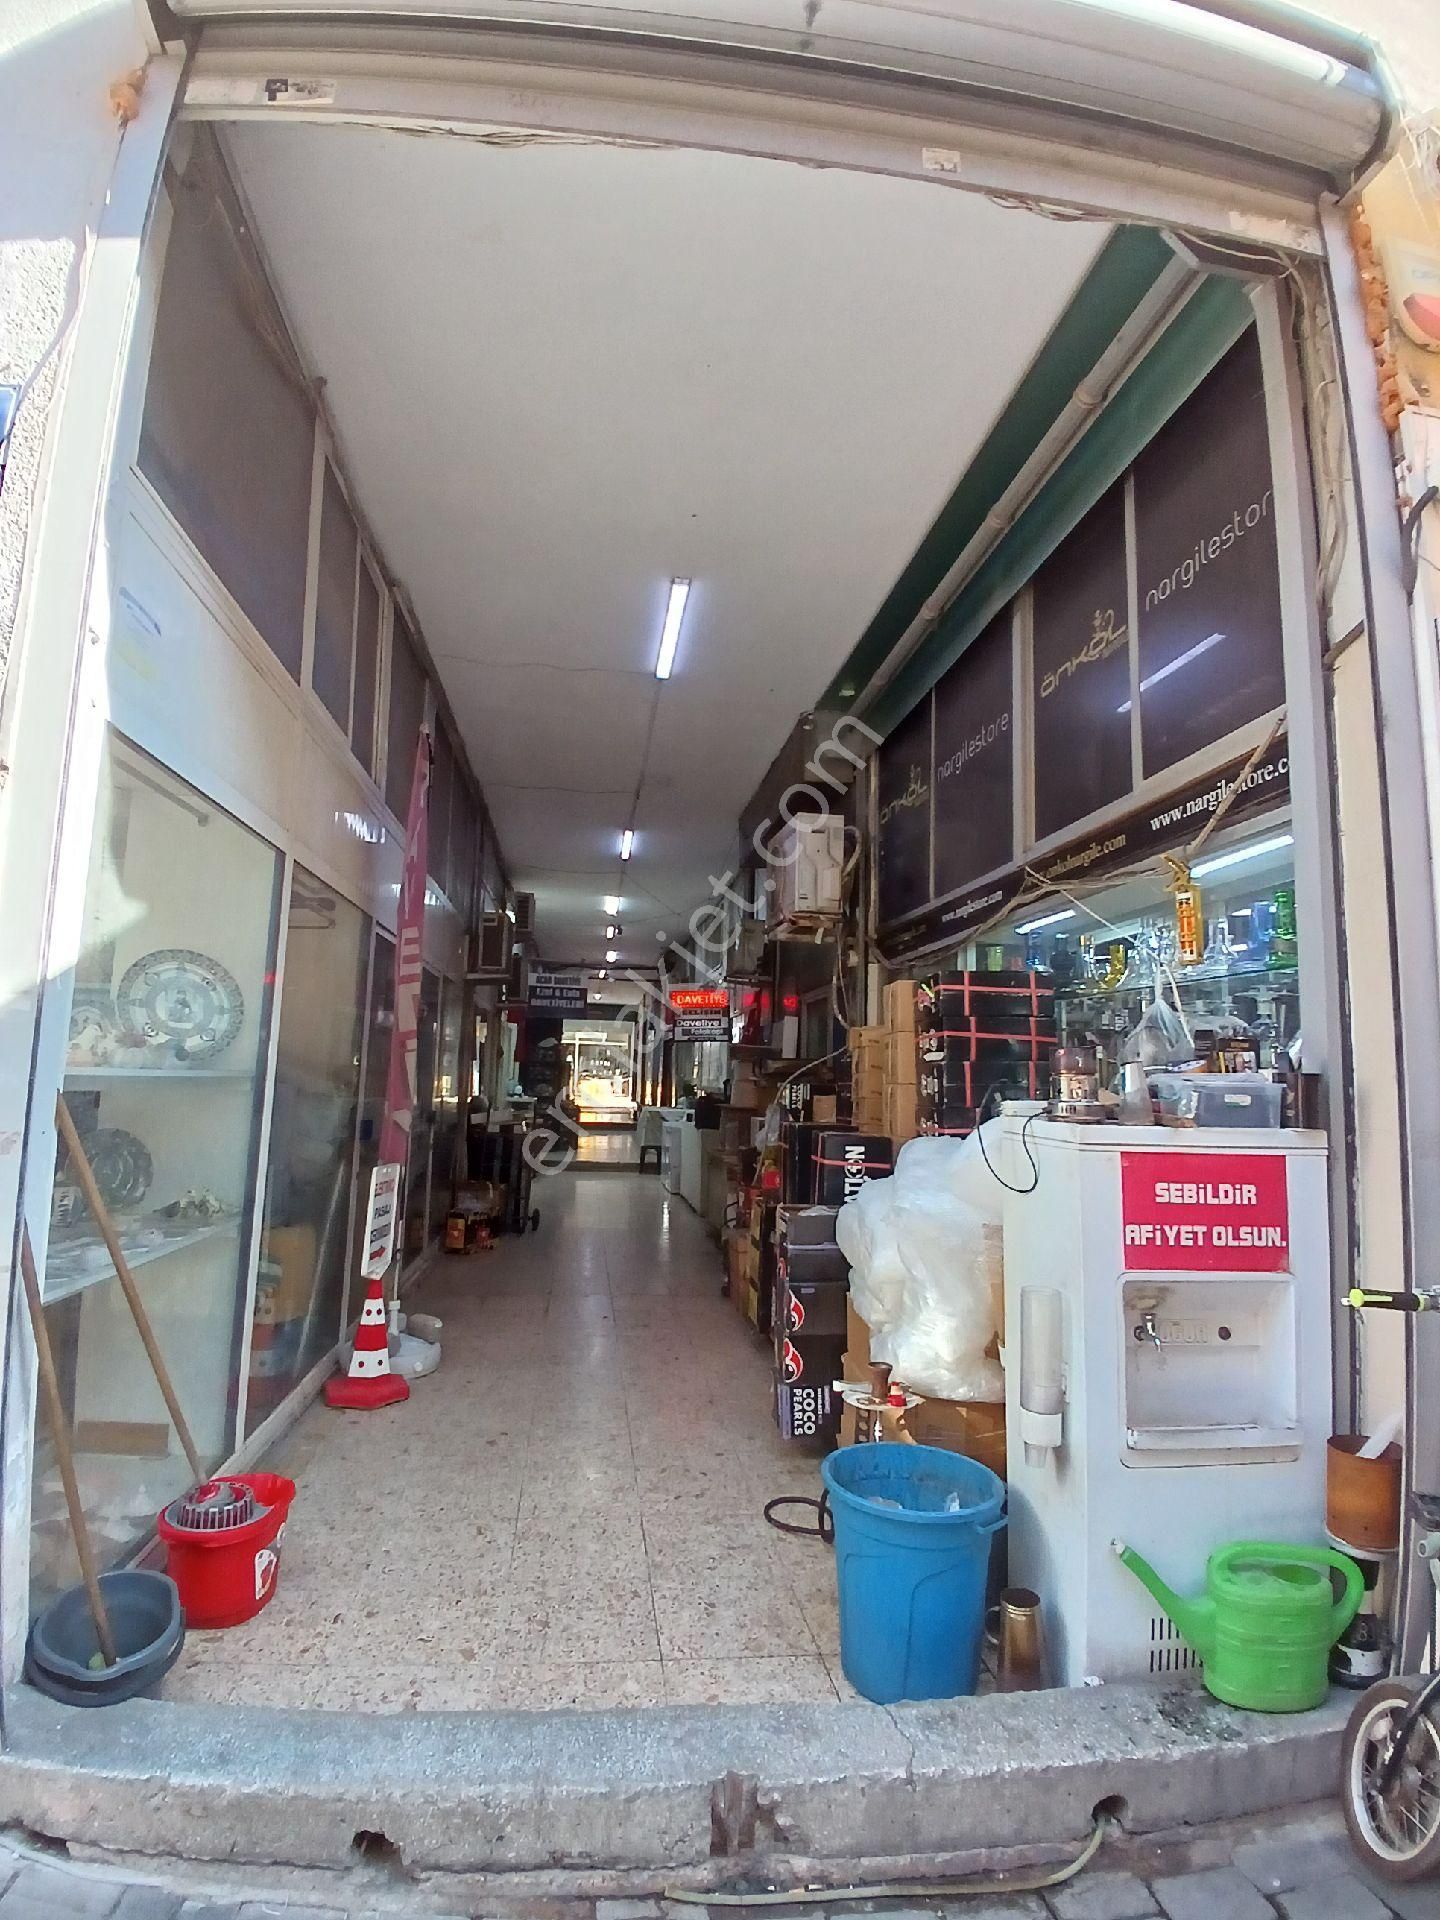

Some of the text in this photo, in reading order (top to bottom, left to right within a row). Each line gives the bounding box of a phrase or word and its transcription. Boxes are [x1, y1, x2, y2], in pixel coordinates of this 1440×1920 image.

[937, 713, 1009, 783] nargilestore
[793, 1388, 804, 1436] PEARLS
[803, 1389, 816, 1434] COCO
